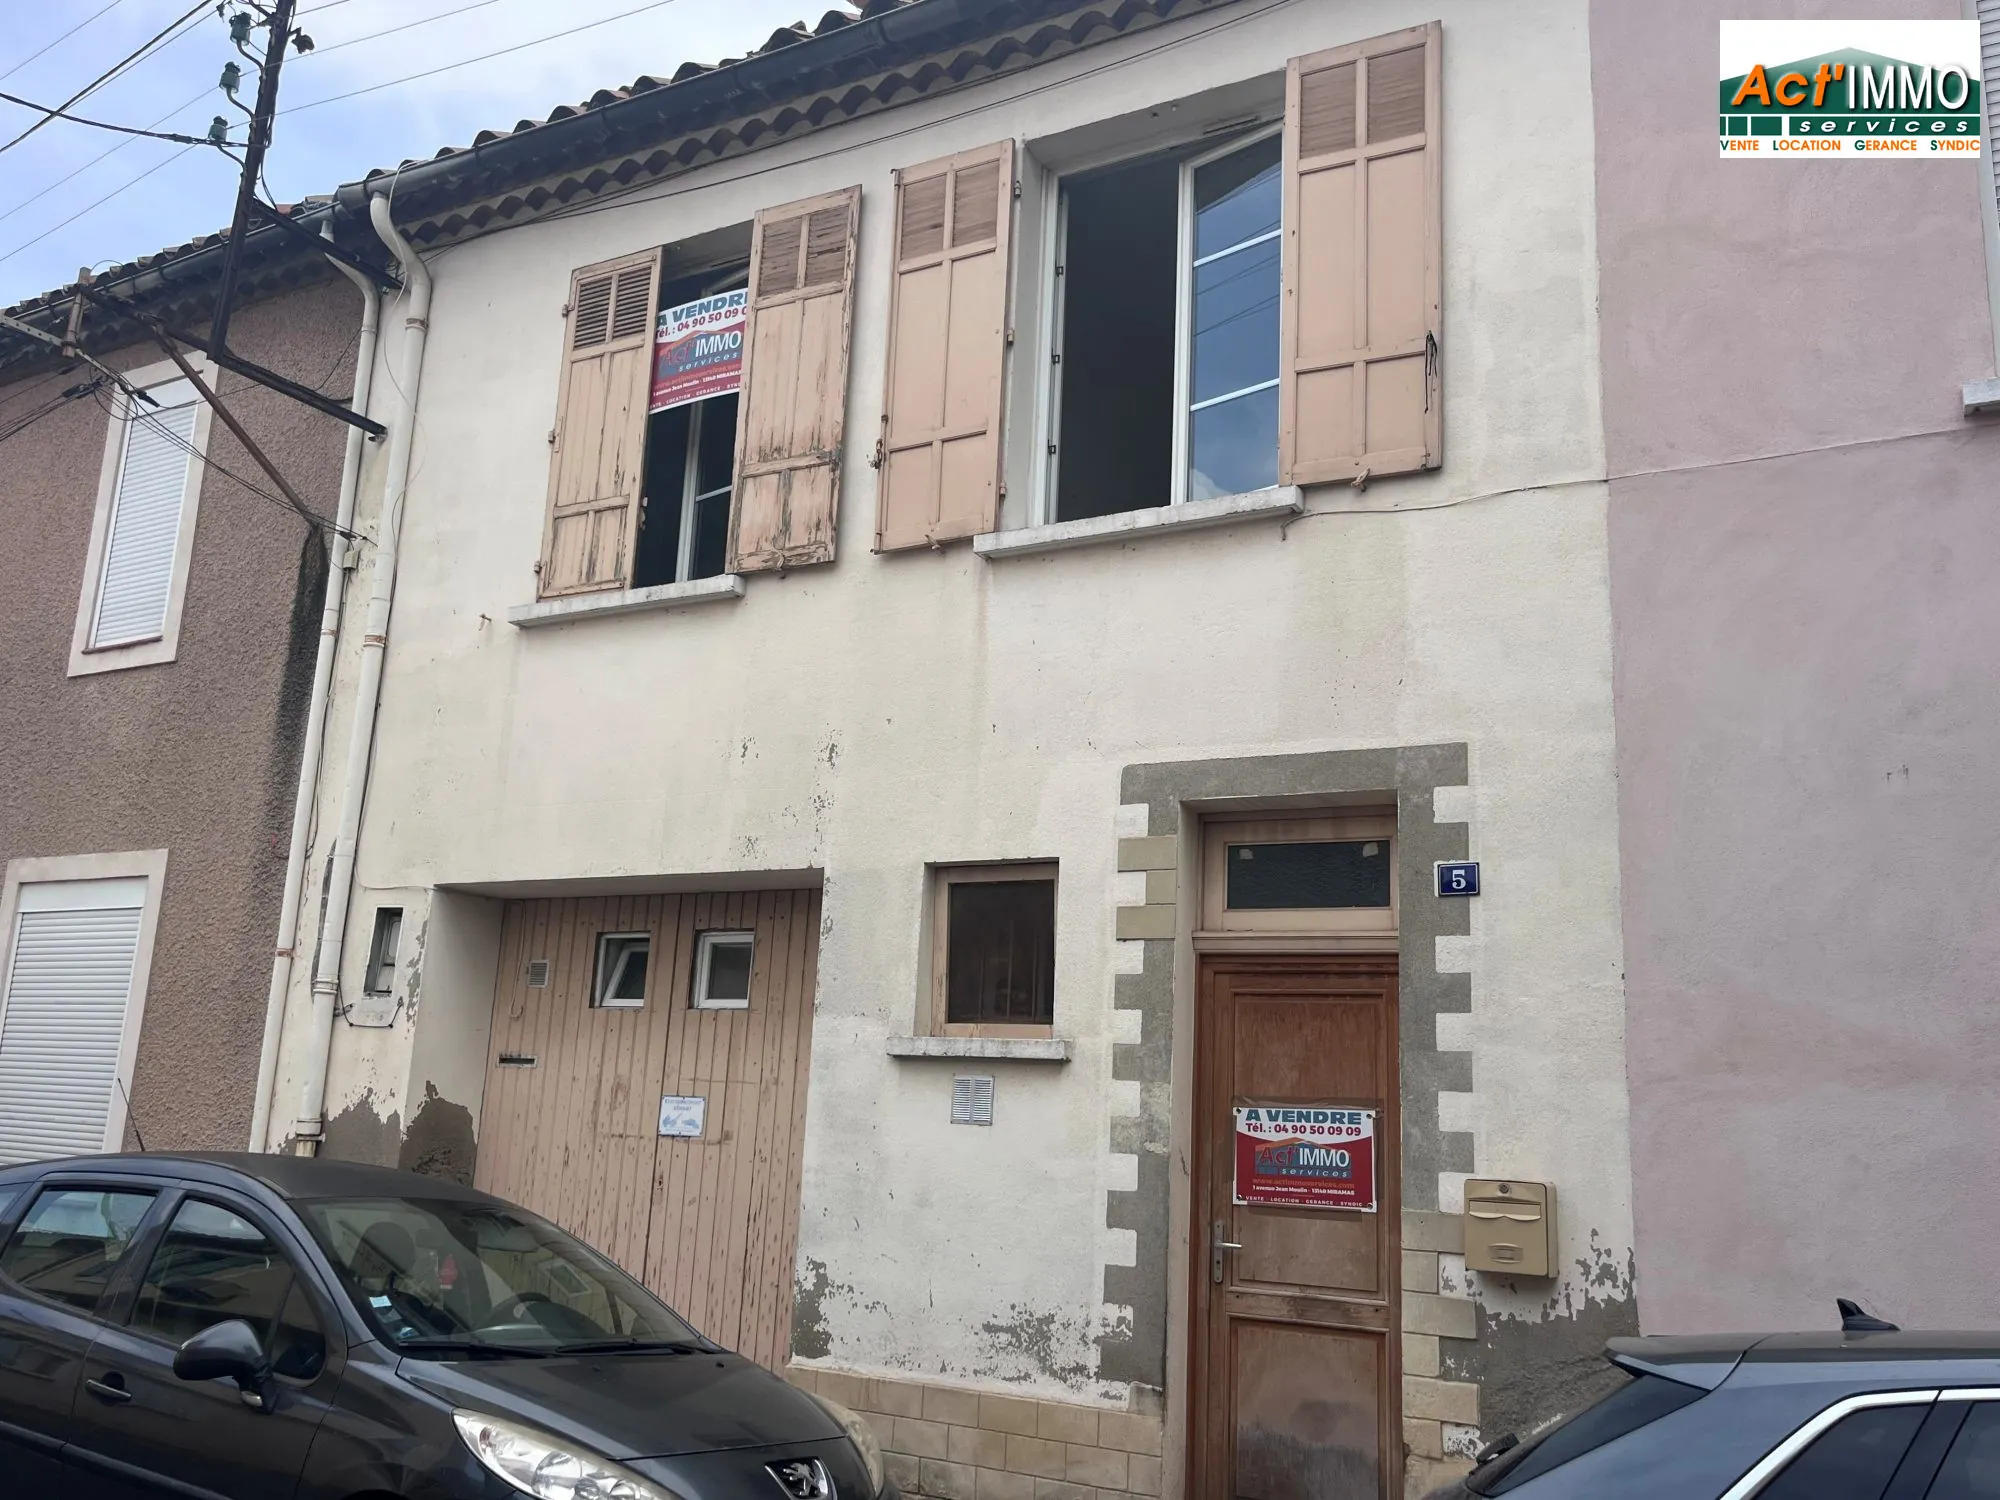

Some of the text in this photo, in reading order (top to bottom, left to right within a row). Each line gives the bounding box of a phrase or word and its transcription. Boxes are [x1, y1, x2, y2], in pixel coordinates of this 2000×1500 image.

[656, 292, 748, 327] A VENDR
[677, 321, 690, 332] 04
[692, 316, 705, 328] 90
[708, 312, 722, 323] 50
[724, 308, 738, 319] 09
[679, 352, 738, 372] services
[1452, 869, 1466, 889] 5
[1246, 1109, 1361, 1125] A VENDRE
[1274, 1124, 1288, 1134] 04
[1292, 1124, 1306, 1134] 90
[1310, 1126, 1324, 1135] 50
[1328, 1126, 1342, 1136] 09
[1346, 1126, 1362, 1136] 09
[1282, 1168, 1347, 1178] services
